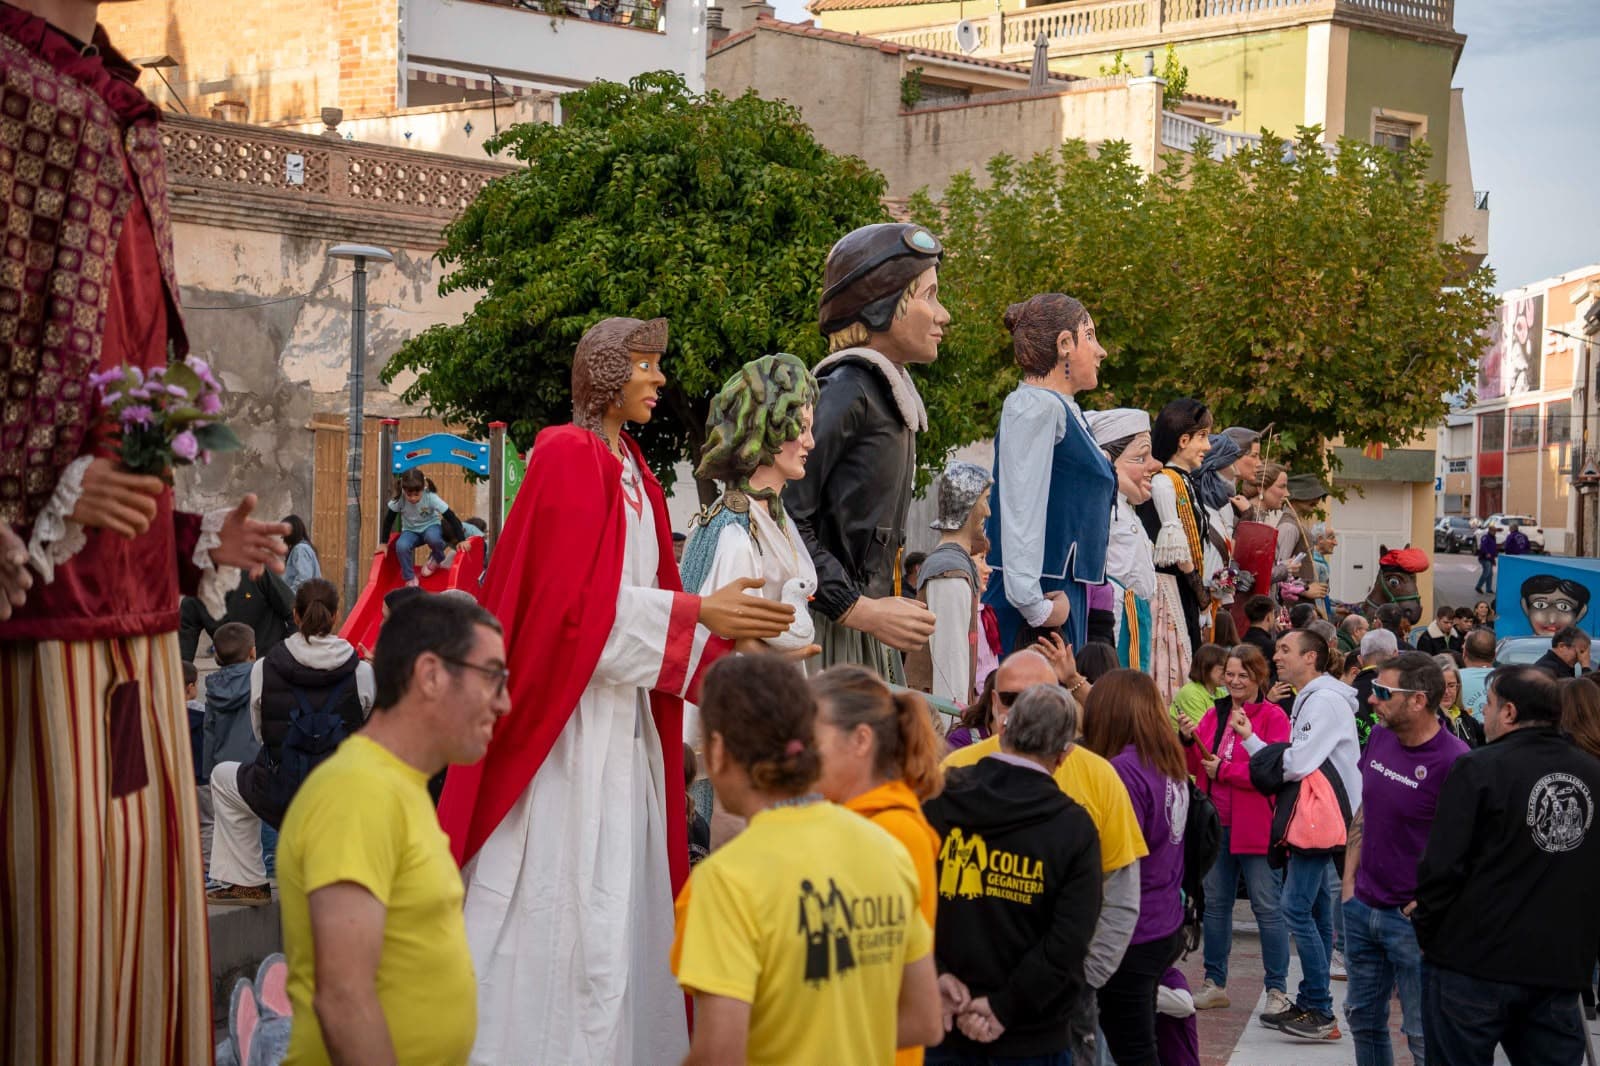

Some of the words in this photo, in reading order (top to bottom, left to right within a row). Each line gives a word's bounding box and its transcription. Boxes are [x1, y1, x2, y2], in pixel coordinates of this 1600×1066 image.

[1370, 760, 1384, 773] Colla
[1384, 768, 1418, 789] gegantera
[989, 850, 1044, 881] COLLA
[987, 873, 1045, 895] GEGANTERA
[851, 896, 906, 930] COLLA
